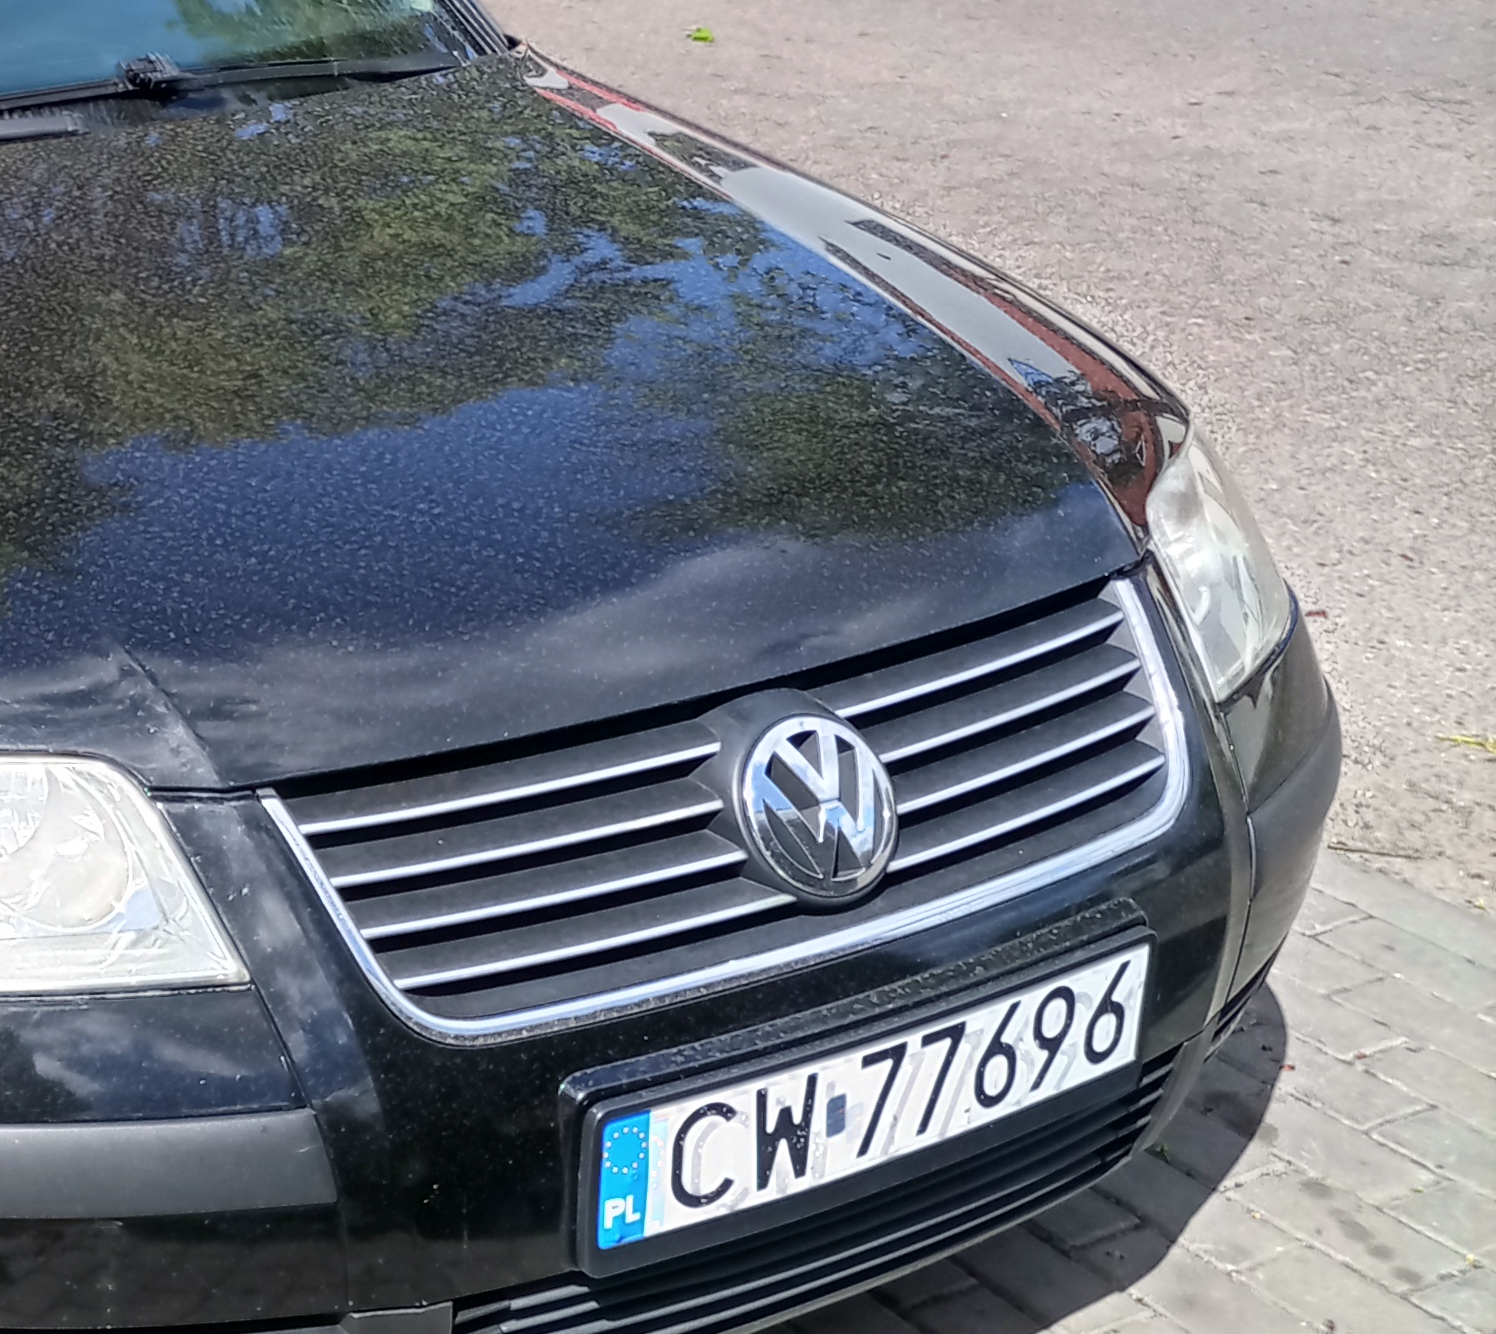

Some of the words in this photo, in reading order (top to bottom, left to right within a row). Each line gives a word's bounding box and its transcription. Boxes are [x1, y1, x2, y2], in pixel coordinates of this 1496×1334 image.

[669, 1072, 820, 1208] CW
[855, 959, 1133, 1158] 77696
[603, 1196, 641, 1231] PL
